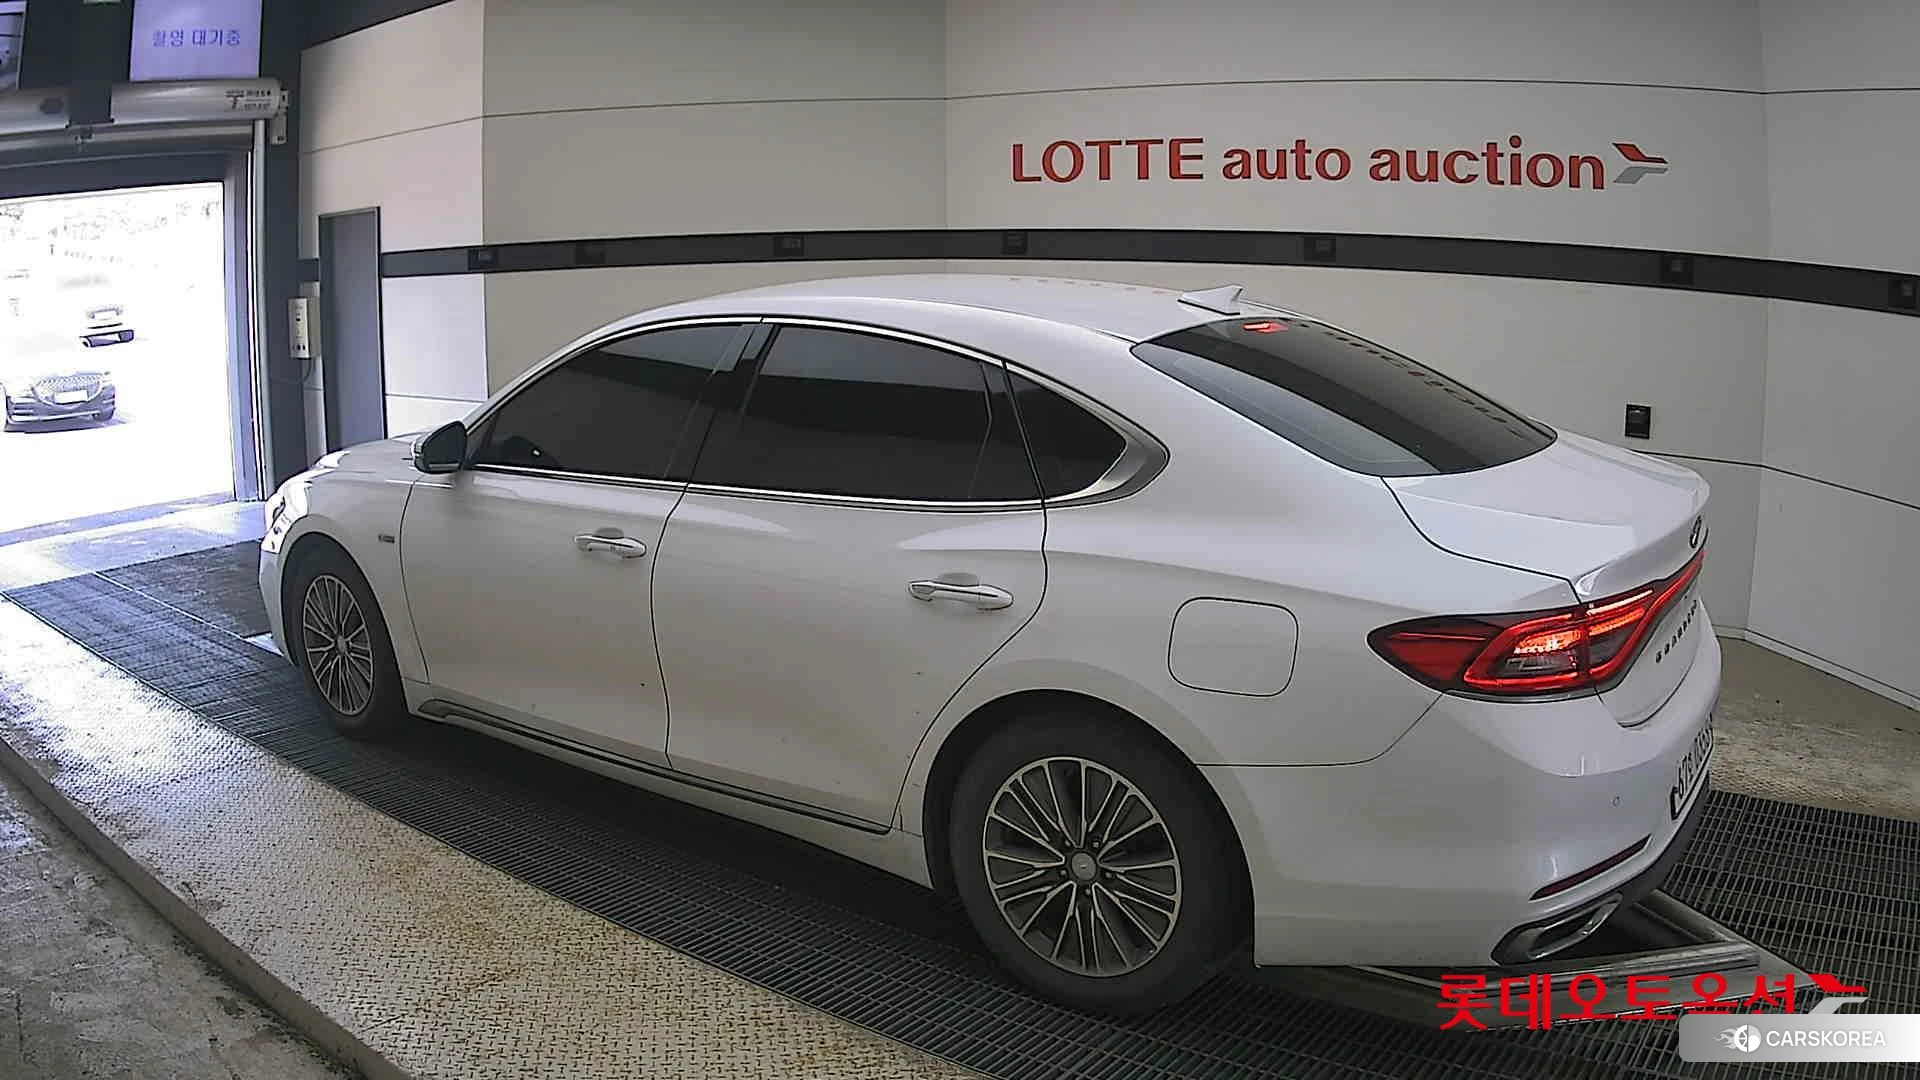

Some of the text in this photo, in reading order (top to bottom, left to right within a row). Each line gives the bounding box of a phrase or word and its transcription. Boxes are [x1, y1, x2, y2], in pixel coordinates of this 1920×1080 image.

[192, 29, 240, 47] 대기중
[1012, 135, 1606, 190] LOTTE auto auction
